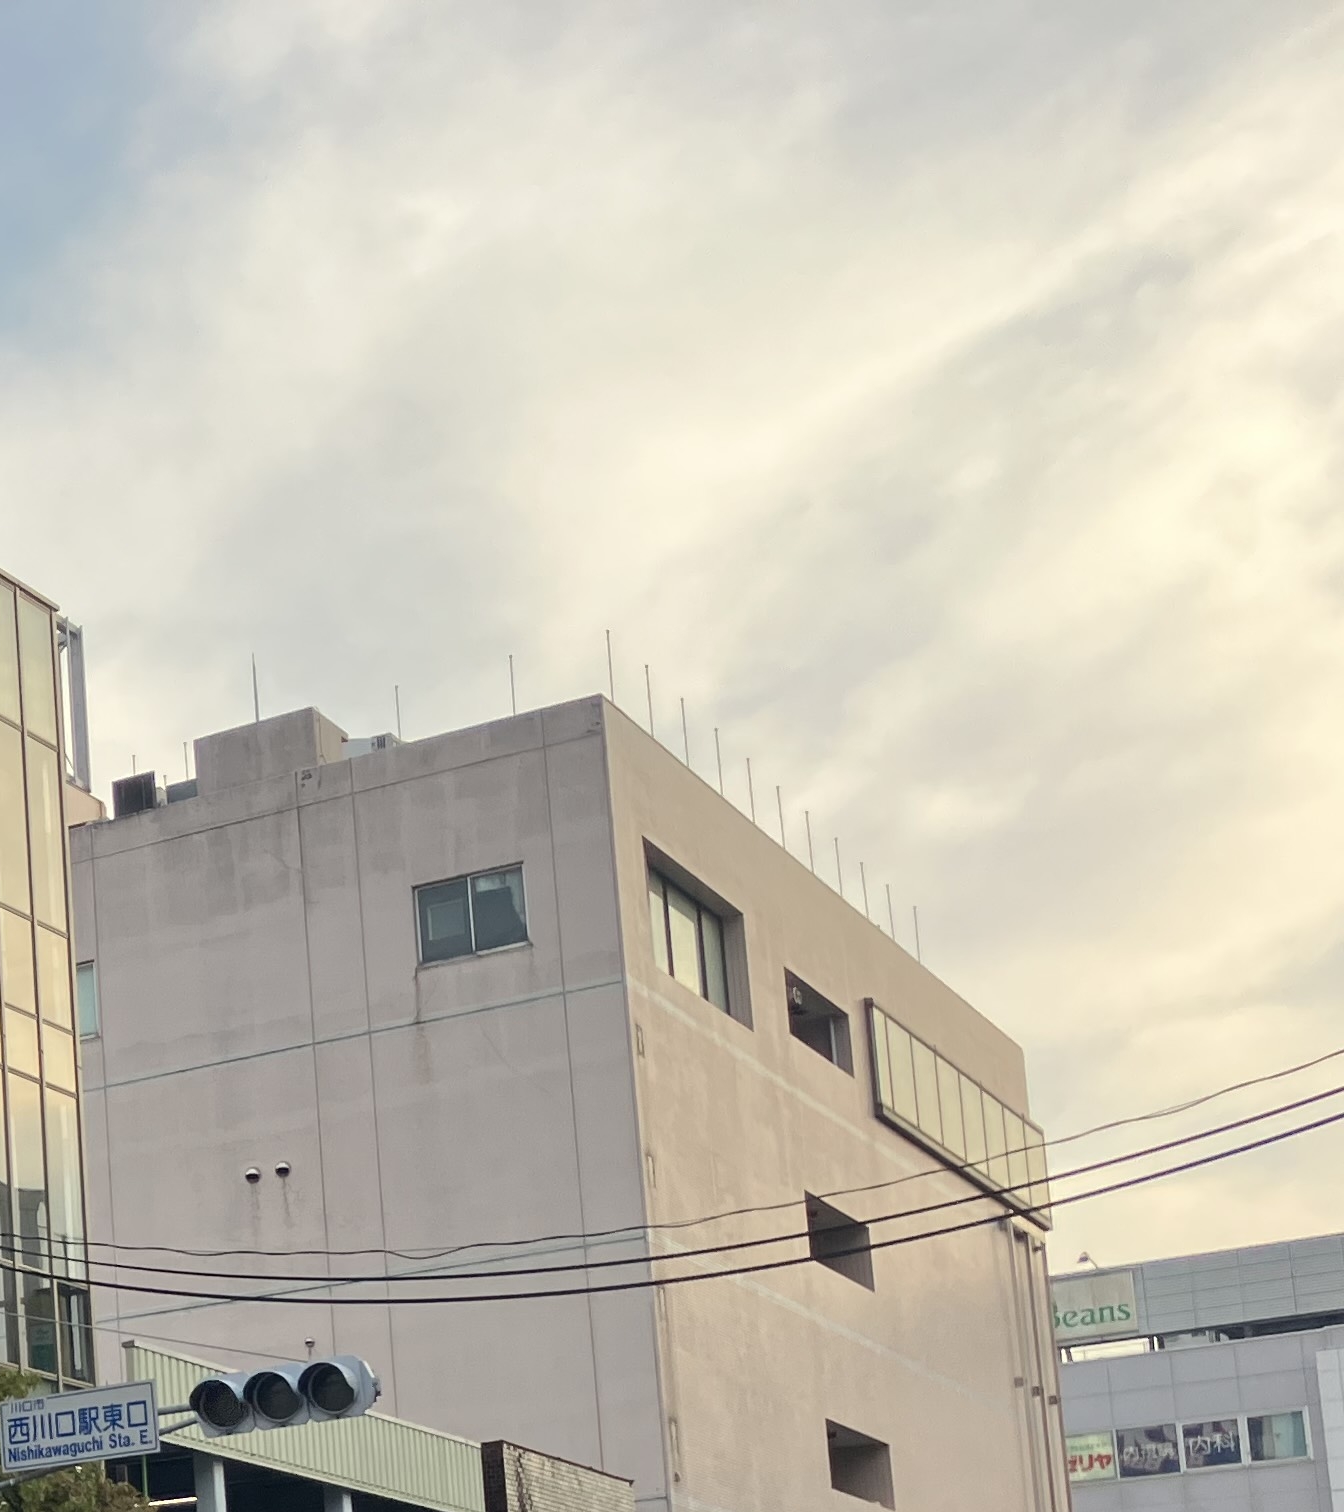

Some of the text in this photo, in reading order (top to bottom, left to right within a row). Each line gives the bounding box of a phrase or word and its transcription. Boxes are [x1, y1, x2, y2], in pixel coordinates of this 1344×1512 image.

[10, 1399, 45, 1413] 川口市
[7, 1400, 148, 1445] 西川口駅東口
[8, 1428, 153, 1463] Nishikawaguchi Sta. E.
[1189, 1432, 1236, 1456] 内科
